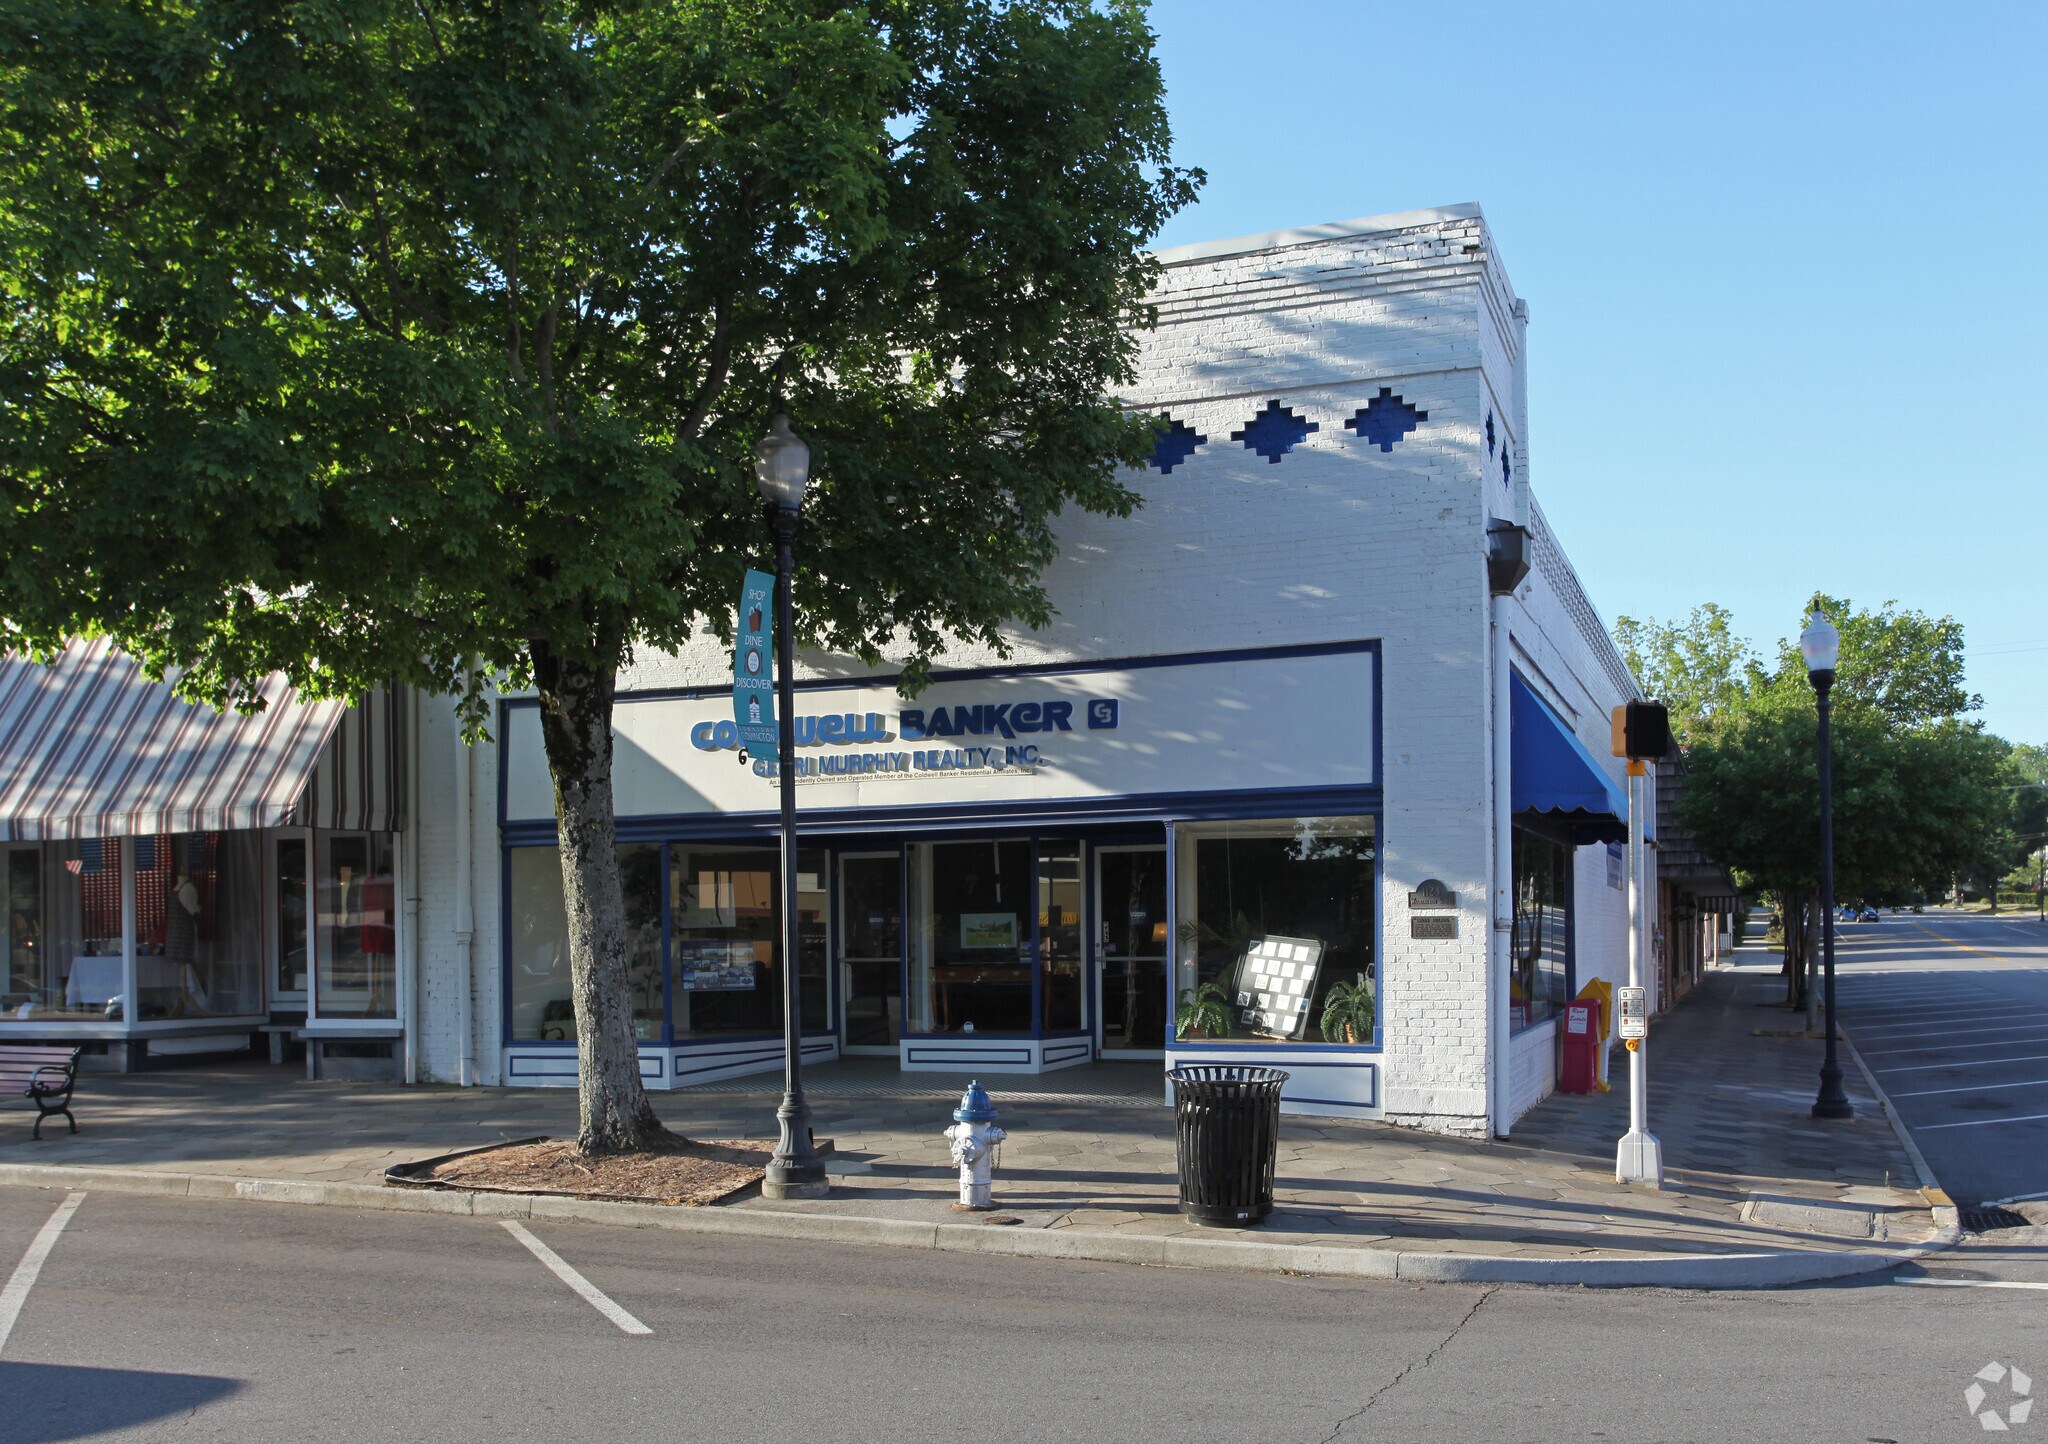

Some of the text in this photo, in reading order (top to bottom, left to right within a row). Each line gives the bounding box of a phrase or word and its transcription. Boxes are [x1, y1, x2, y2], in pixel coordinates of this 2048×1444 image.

[748, 589, 766, 601] SHOP
[745, 634, 763, 647] DINE
[736, 677, 772, 690] DISCOVER
[691, 712, 887, 750] COWELL
[900, 701, 1073, 739] BANKER
[741, 731, 776, 742] COVINGTON
[752, 744, 1044, 777] GERI MURPHY REALTY, INC.
[816, 775, 836, 783] Owned
[836, 774, 847, 782] and
[848, 774, 873, 783] Operated
[873, 772, 896, 780] Member
[904, 771, 913, 779] the
[914, 770, 939, 778] Coldwell
[939, 769, 959, 777] Banker
[960, 768, 992, 776] Residential
